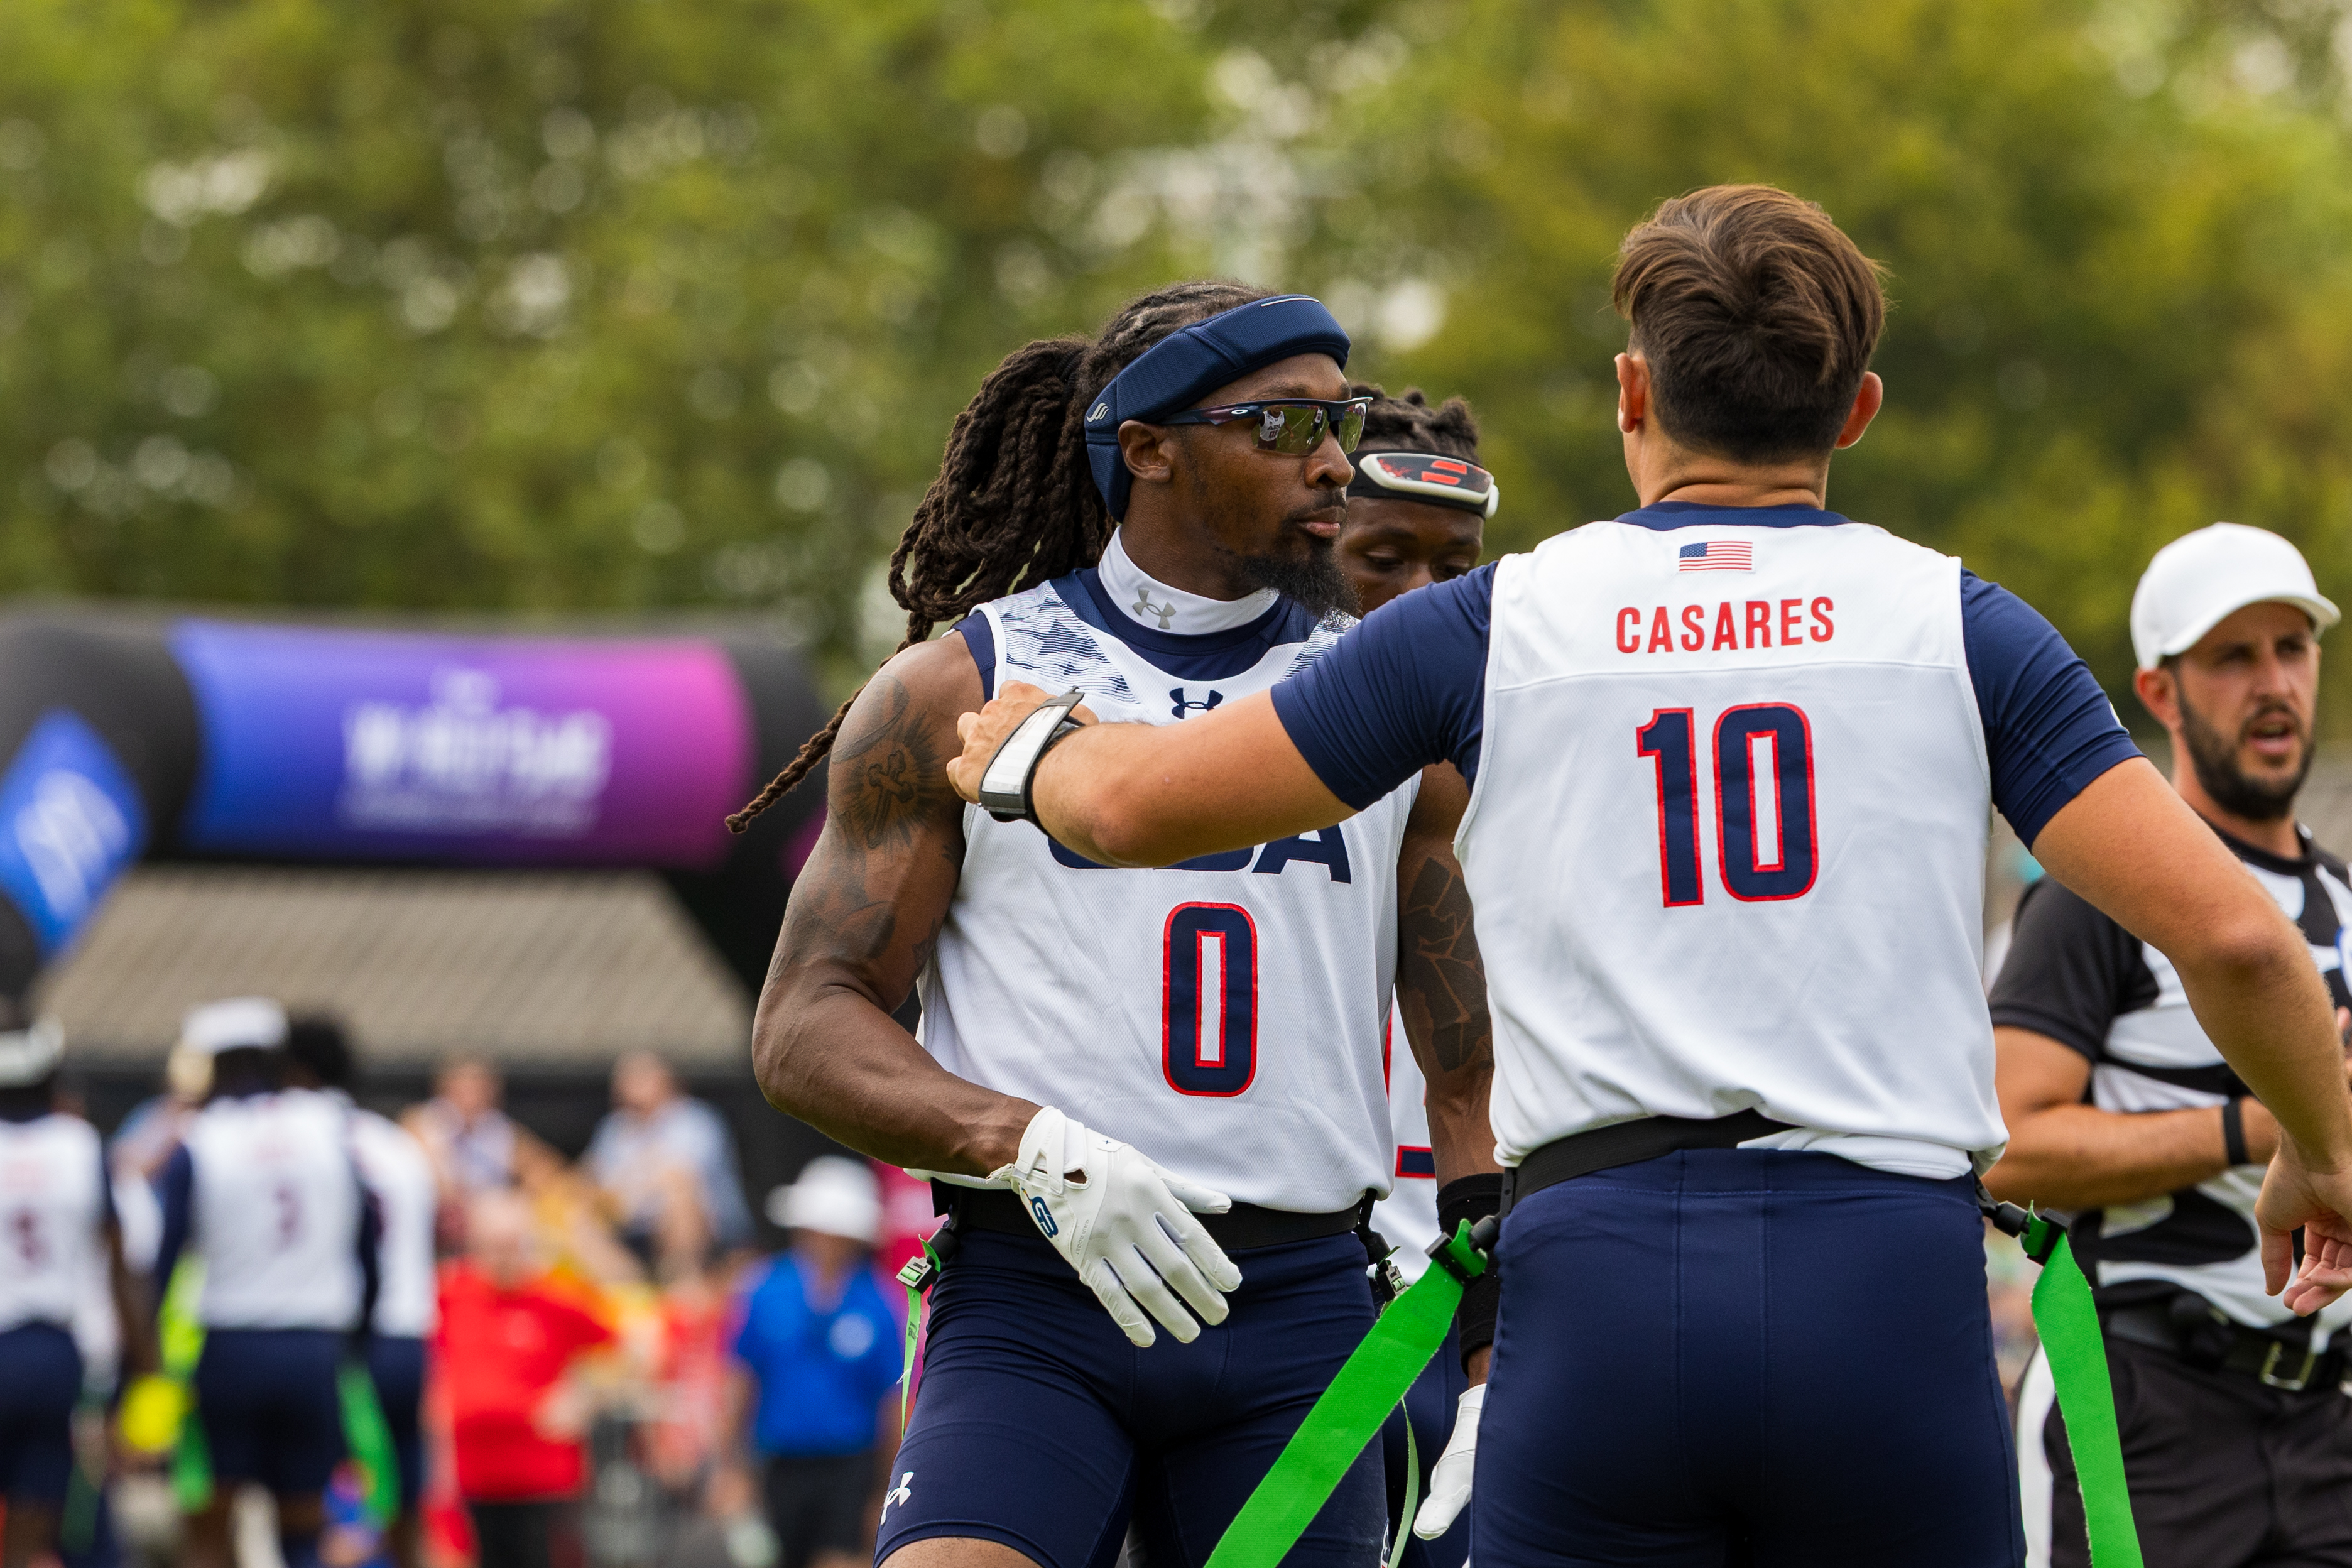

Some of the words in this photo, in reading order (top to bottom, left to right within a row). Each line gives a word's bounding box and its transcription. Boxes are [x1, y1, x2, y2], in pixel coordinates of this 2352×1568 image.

[1616, 596, 1834, 654] CASARES
[1635, 702, 1819, 908] 10
[1162, 901, 1258, 1097] 0
[1075, 1235, 1084, 1255] BOOST
